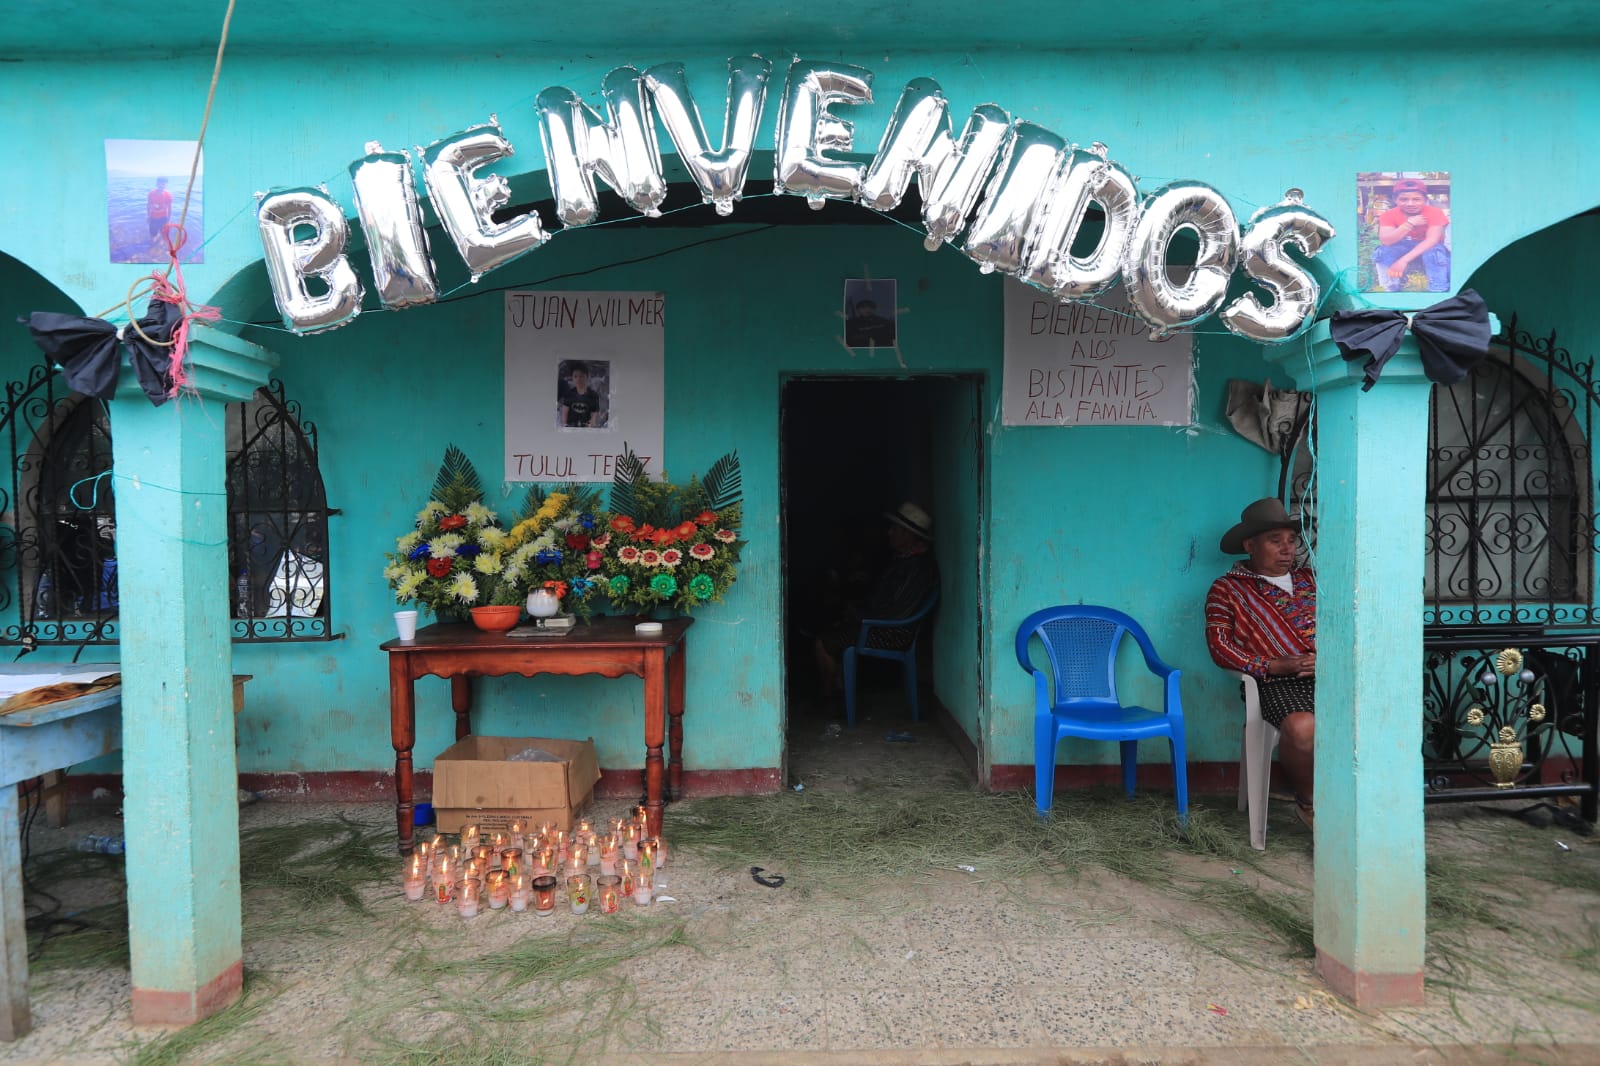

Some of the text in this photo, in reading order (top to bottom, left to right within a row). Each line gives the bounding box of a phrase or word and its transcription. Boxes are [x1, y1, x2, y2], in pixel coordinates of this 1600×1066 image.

[255, 53, 1336, 346] BIENVENIDOS
[512, 293, 665, 329] JUAN WILMER
[1028, 364, 1168, 400] BISITANTES
[513, 454, 576, 477] TULUL
